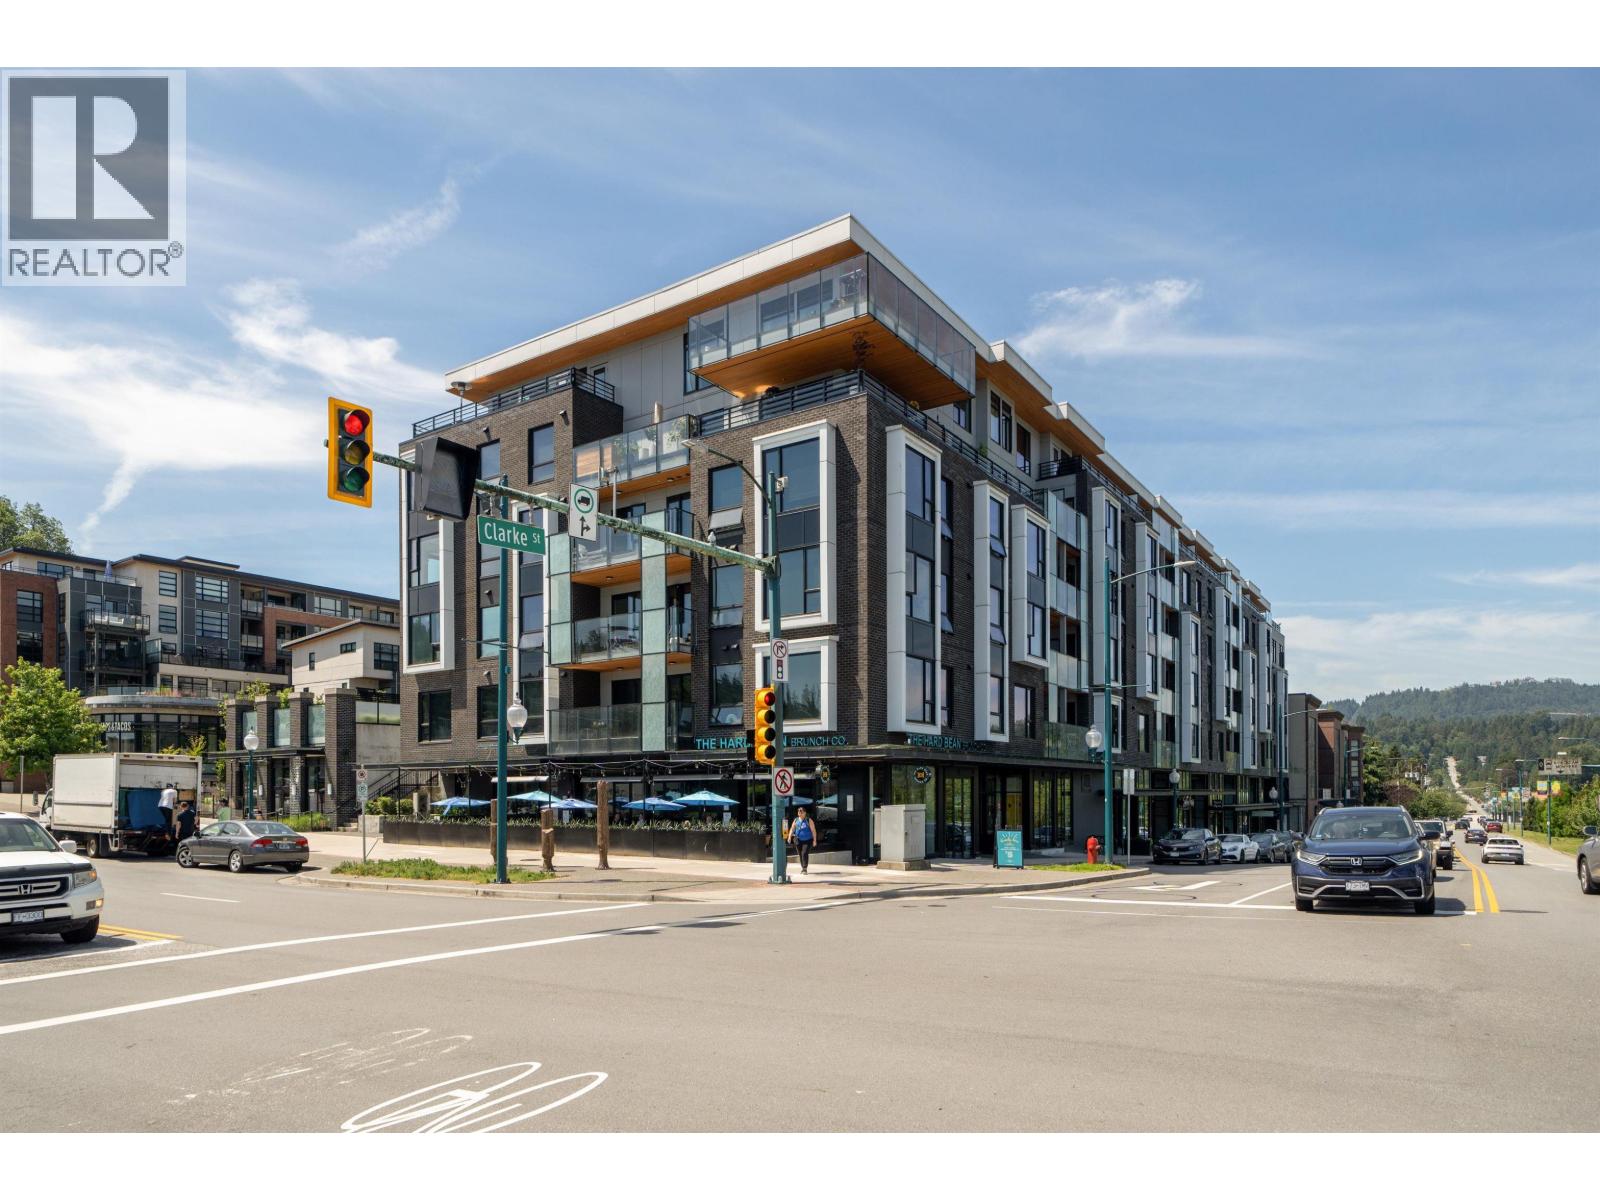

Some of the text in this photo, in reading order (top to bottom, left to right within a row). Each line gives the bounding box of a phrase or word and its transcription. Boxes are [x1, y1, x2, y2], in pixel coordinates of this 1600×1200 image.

[484, 522, 541, 546] Clarke St
[695, 738, 717, 750] THE
[791, 735, 829, 747] BRUNCH
[924, 736, 942, 748] HARD
[944, 737, 961, 749] BEAN
